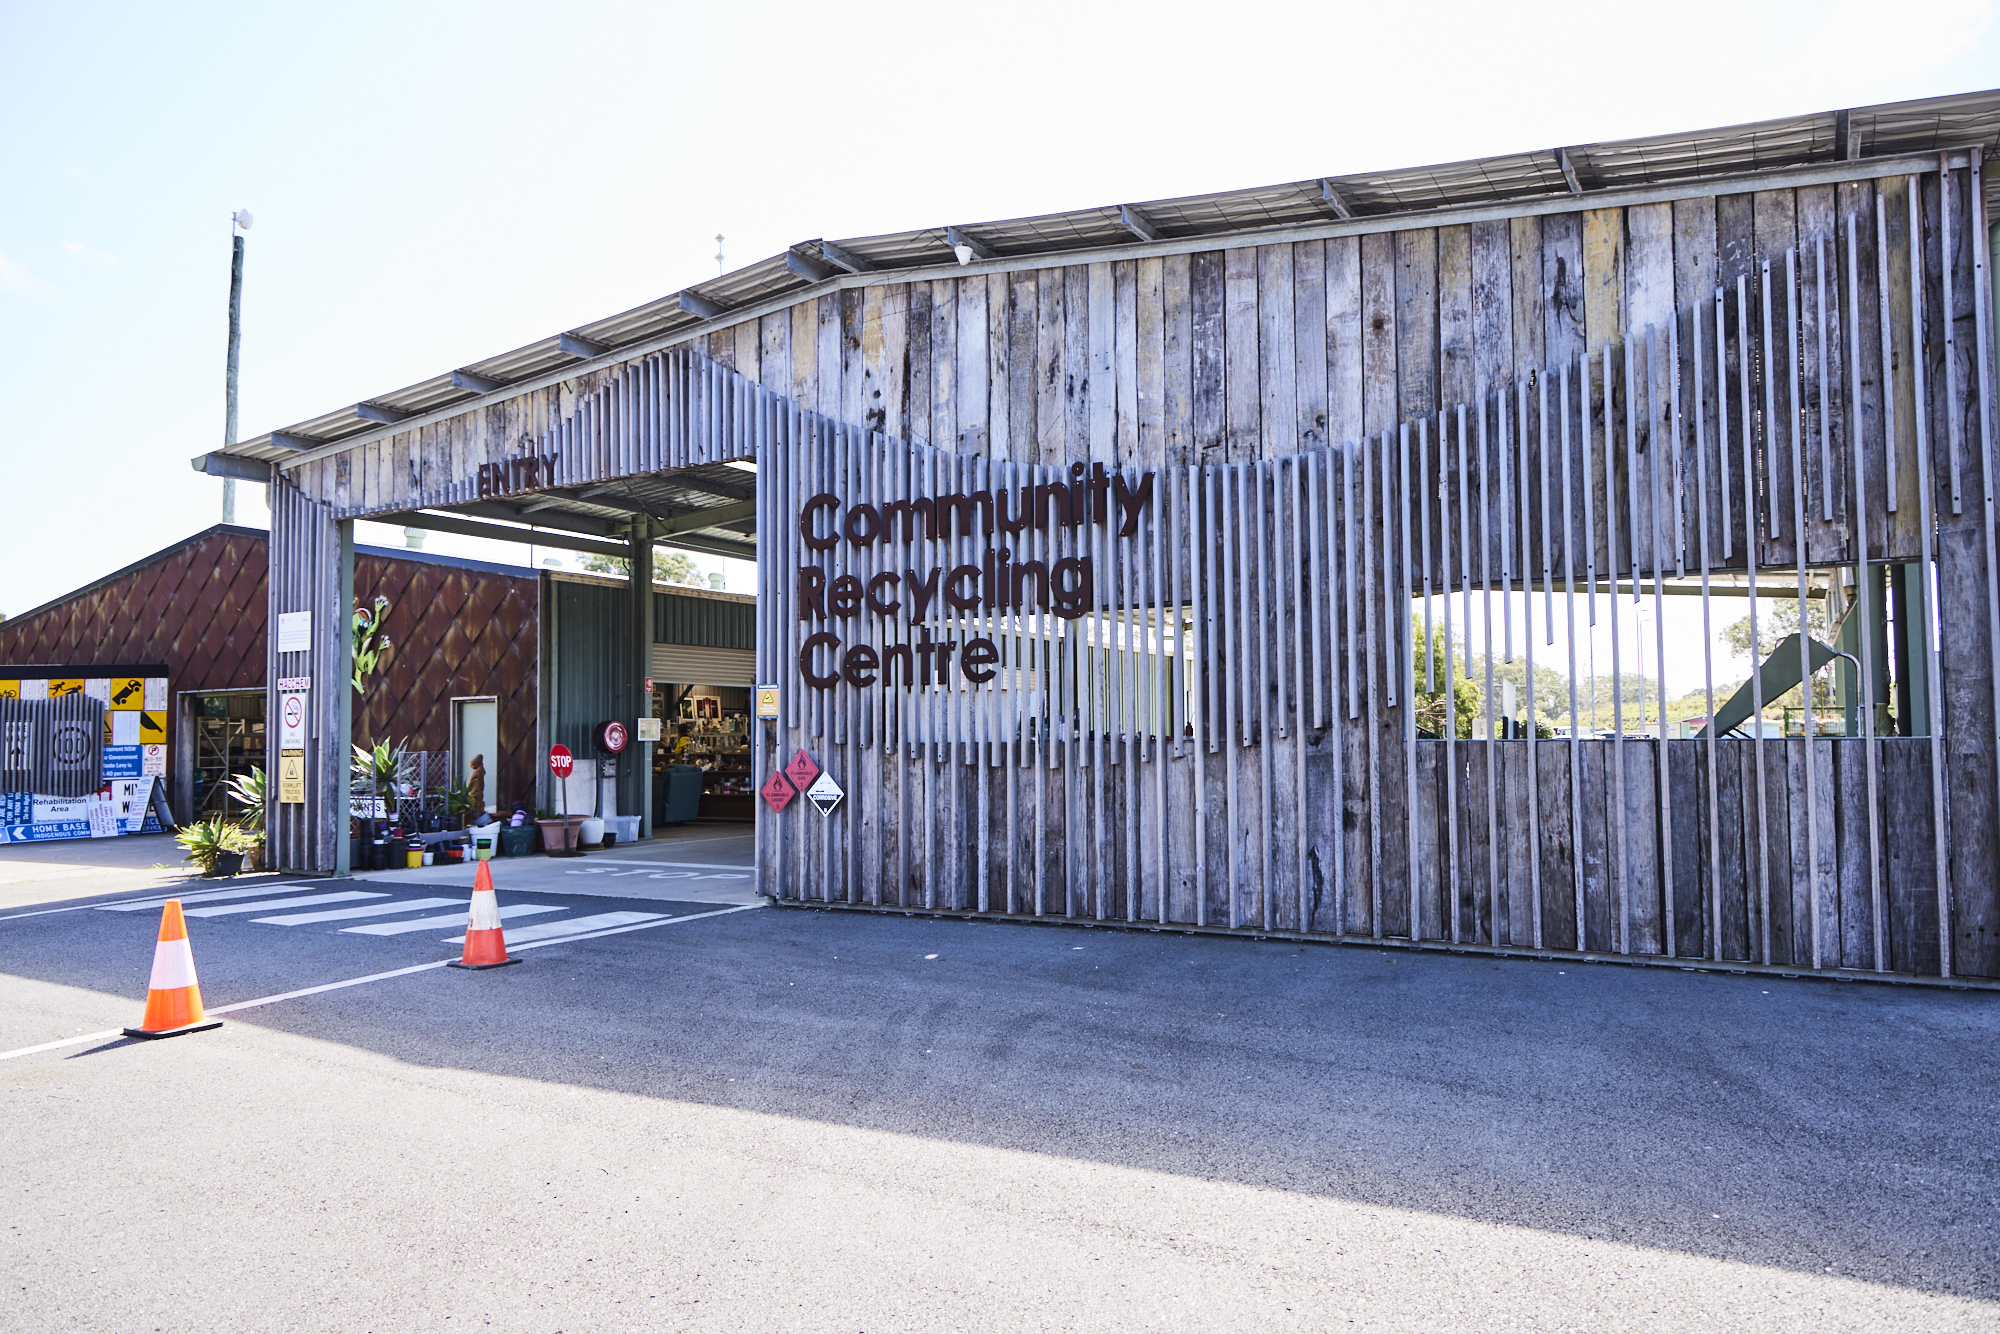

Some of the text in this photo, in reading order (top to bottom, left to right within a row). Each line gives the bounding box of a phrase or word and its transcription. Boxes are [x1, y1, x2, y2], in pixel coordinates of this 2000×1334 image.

[479, 452, 558, 496] ENTRY
[801, 462, 1155, 550] Community
[800, 548, 1092, 626] Recycling
[800, 628, 999, 690] Centre
[551, 755, 572, 768] STOP
[63, 823, 87, 831] BASE
[565, 867, 750, 880] STOP
